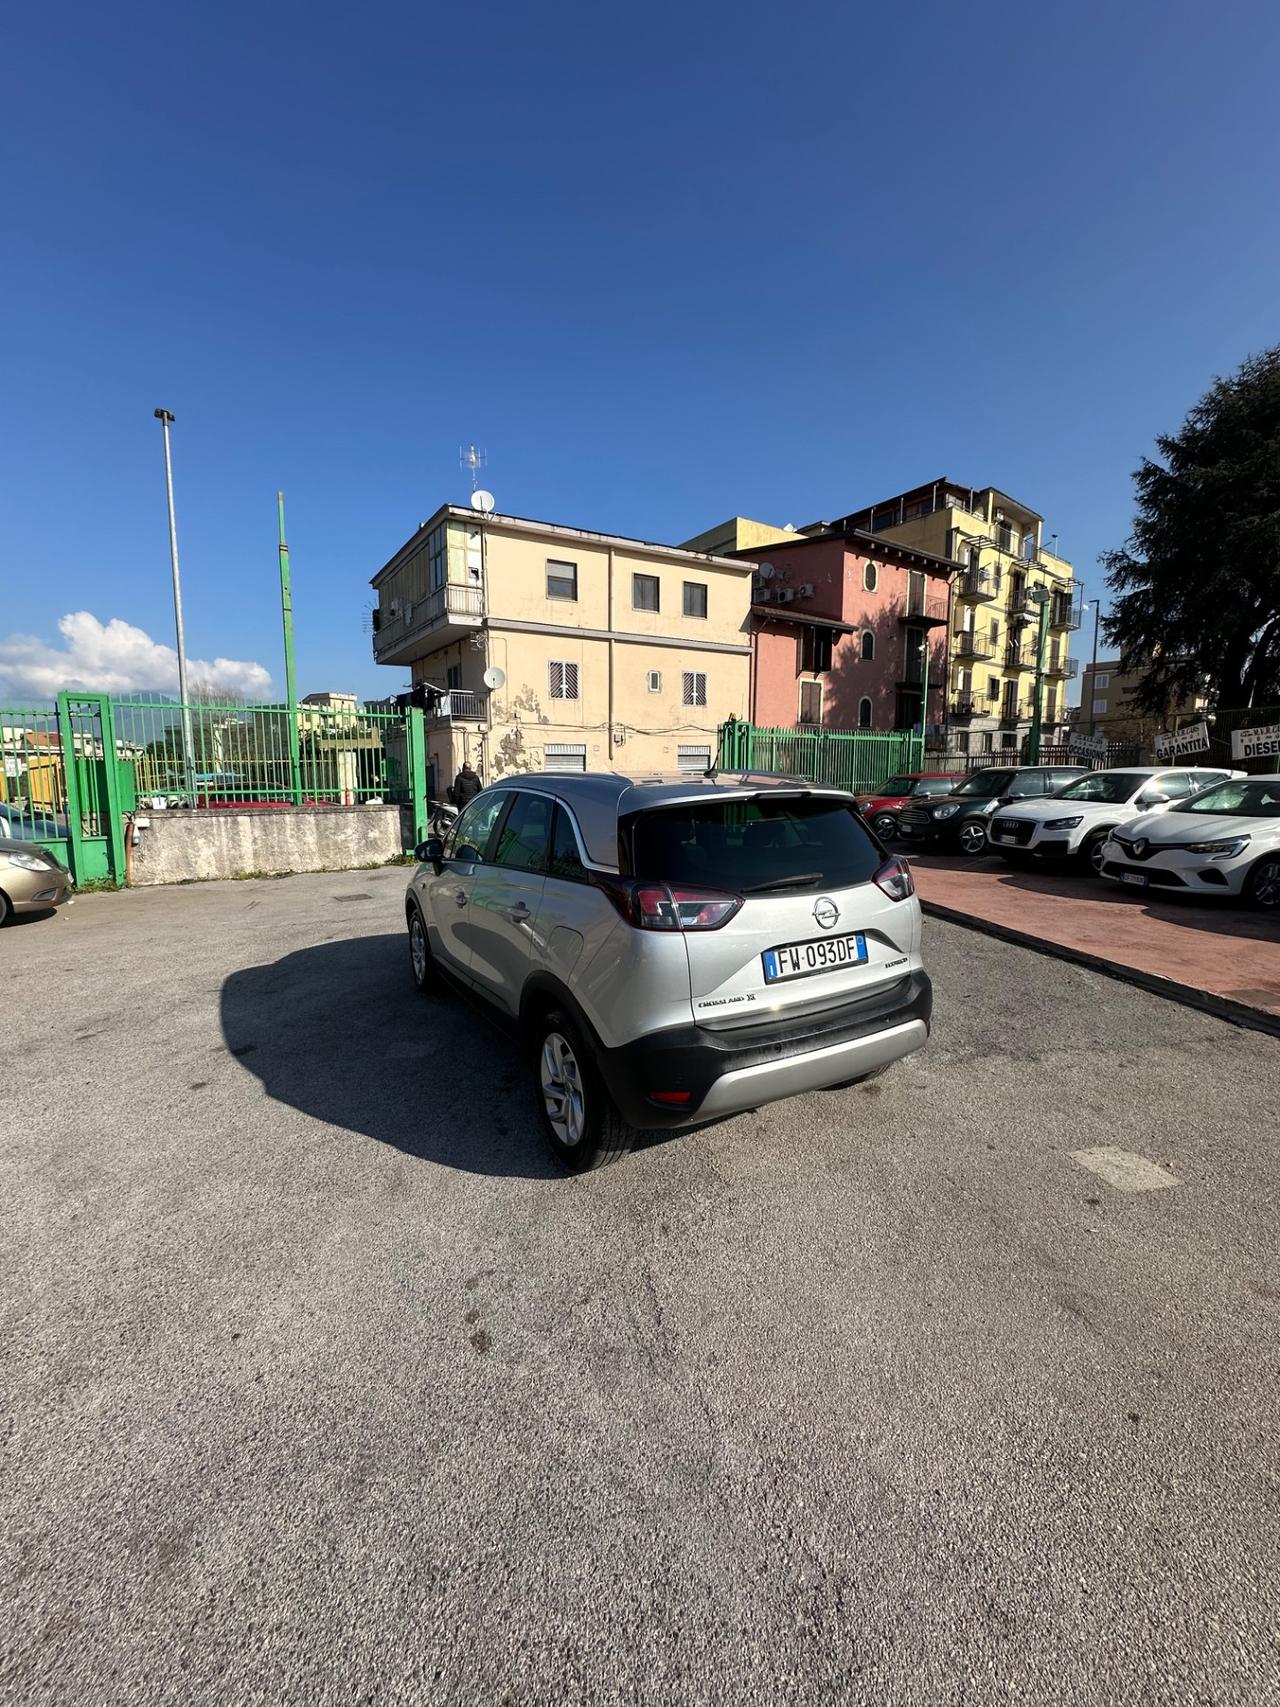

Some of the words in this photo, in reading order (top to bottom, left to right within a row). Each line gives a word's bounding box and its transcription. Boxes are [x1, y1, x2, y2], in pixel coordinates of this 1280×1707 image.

[1068, 744, 1105, 761] OCCASIONE
[1156, 737, 1208, 759] GARANTITA
[778, 947, 801, 974] FW
[806, 937, 855, 968] 093DF
[698, 996, 745, 1008] CROSSLAND
